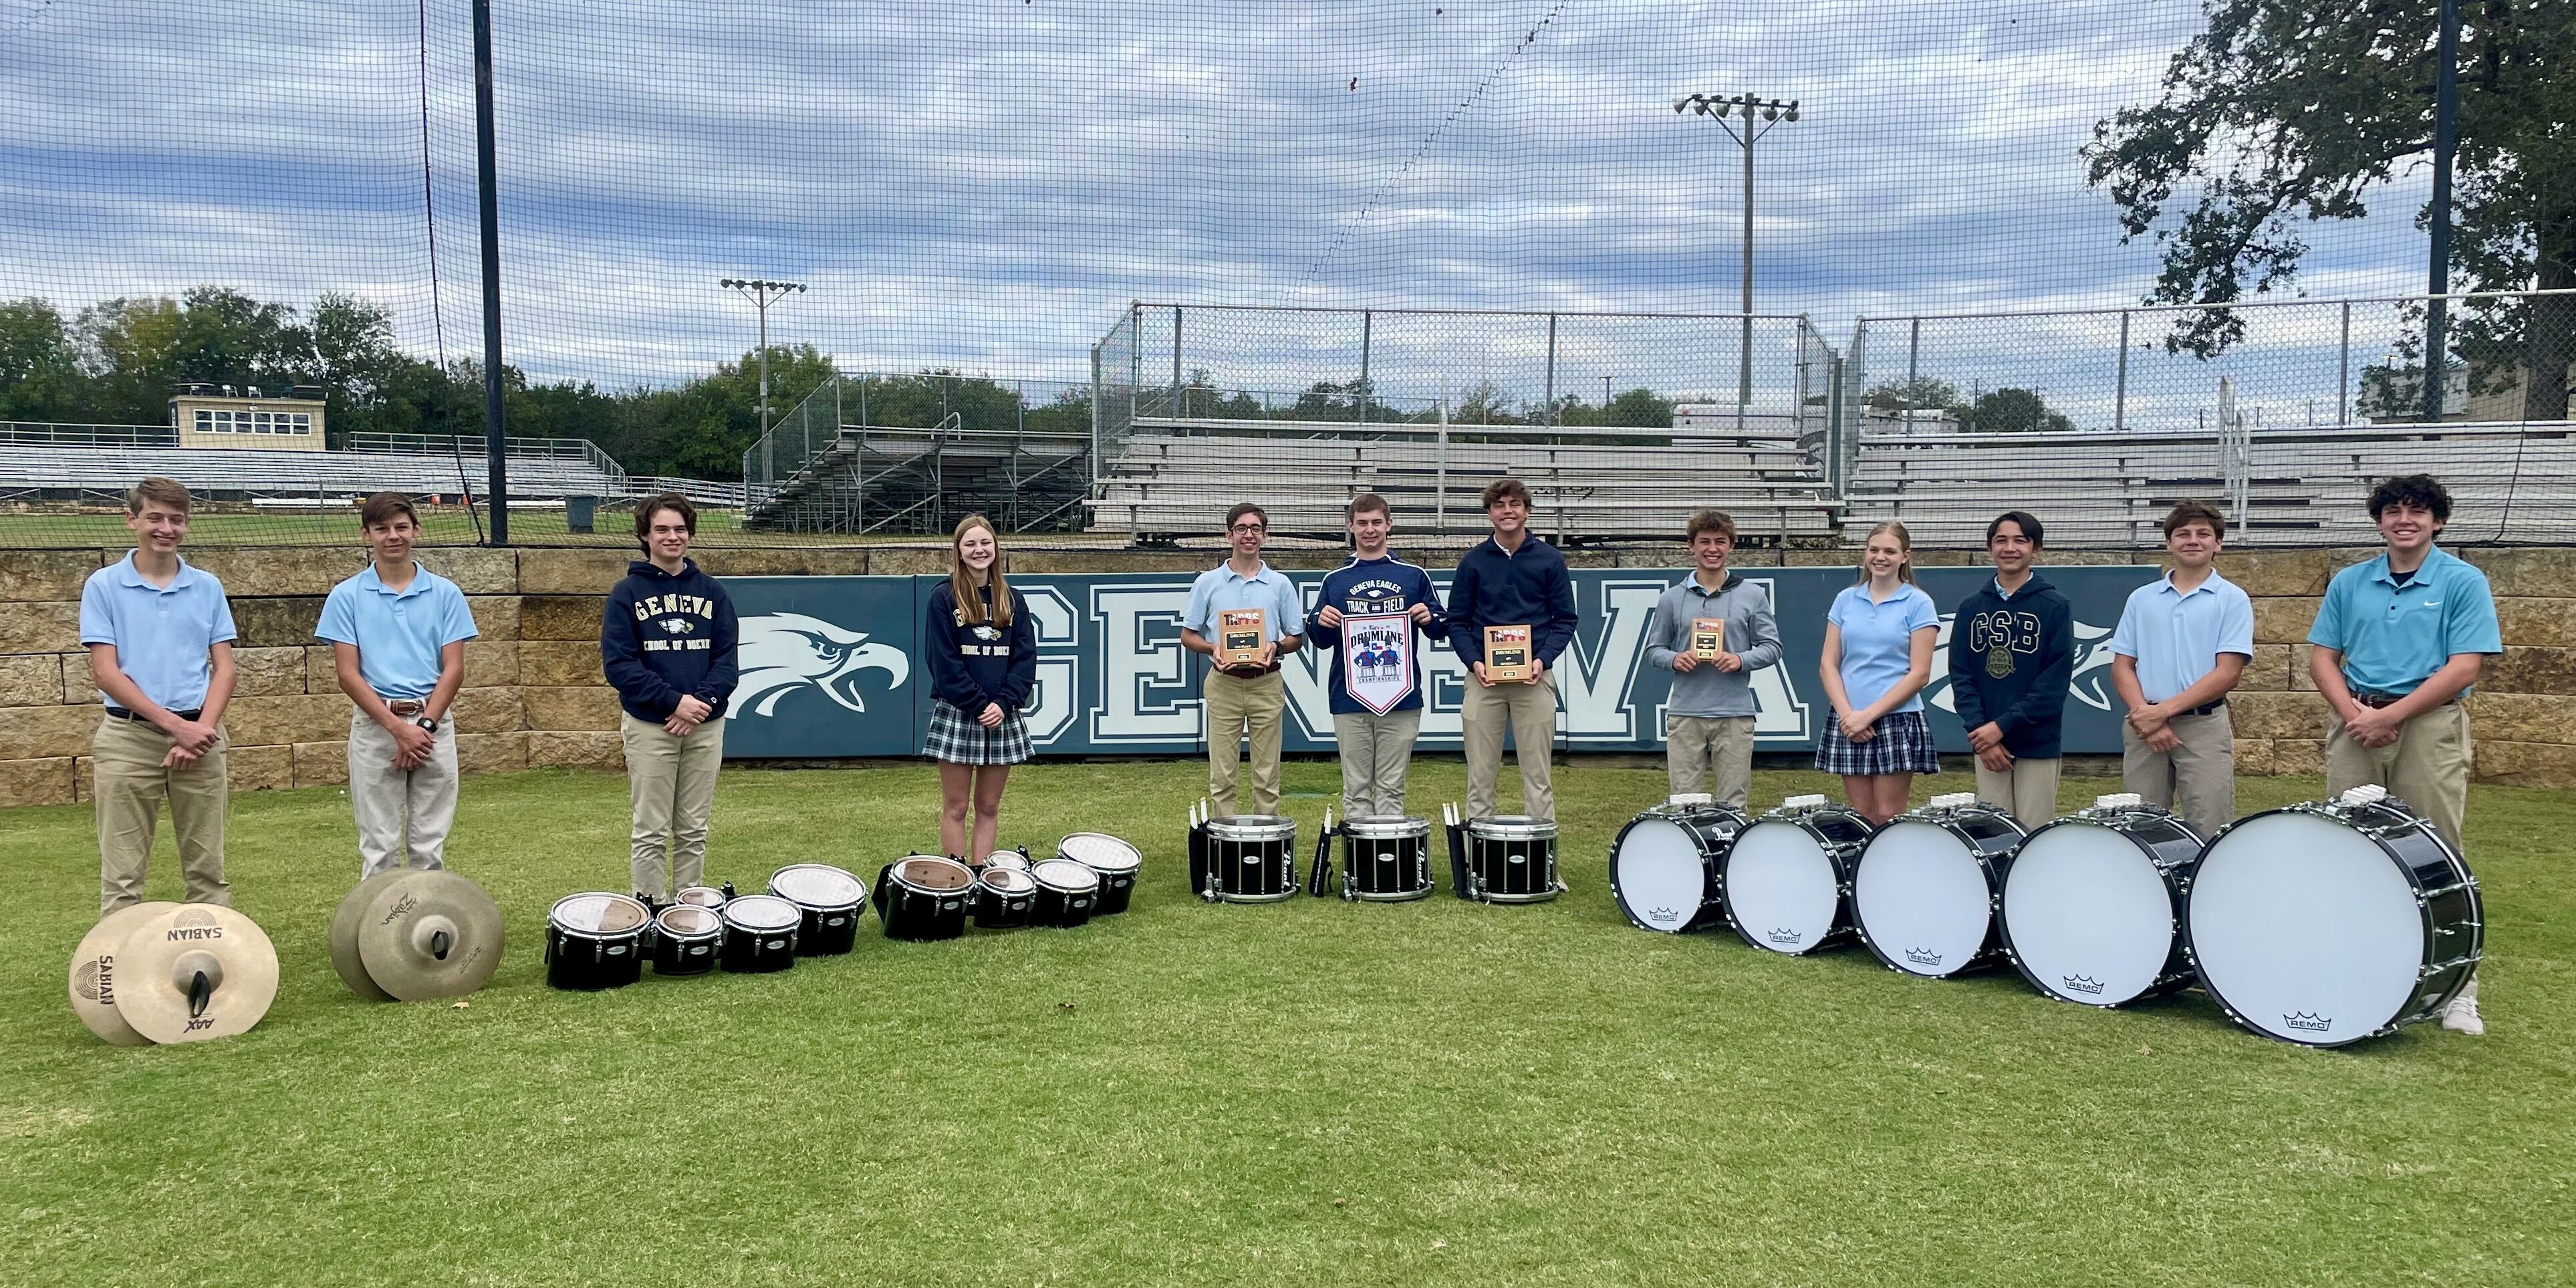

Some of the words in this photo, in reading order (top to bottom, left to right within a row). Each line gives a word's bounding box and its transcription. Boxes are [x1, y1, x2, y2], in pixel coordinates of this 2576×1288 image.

[1376, 579, 1402, 594] EAGLES
[634, 593, 713, 621] GENEVA
[1346, 600, 1370, 614] TRACK
[1383, 598, 1404, 614] FIELD
[1224, 612, 1261, 626] TAPPS
[1489, 630, 1526, 643] TAPPS
[1970, 610, 2041, 654] GSB
[168, 926, 222, 942] SABIAN
[1910, 954, 1937, 964] REMO
[100, 954, 114, 1005] SABIAN
[2069, 981, 2098, 992] REMO
[183, 1017, 215, 1033] AAX
[2290, 1020, 2325, 1029] REMO
